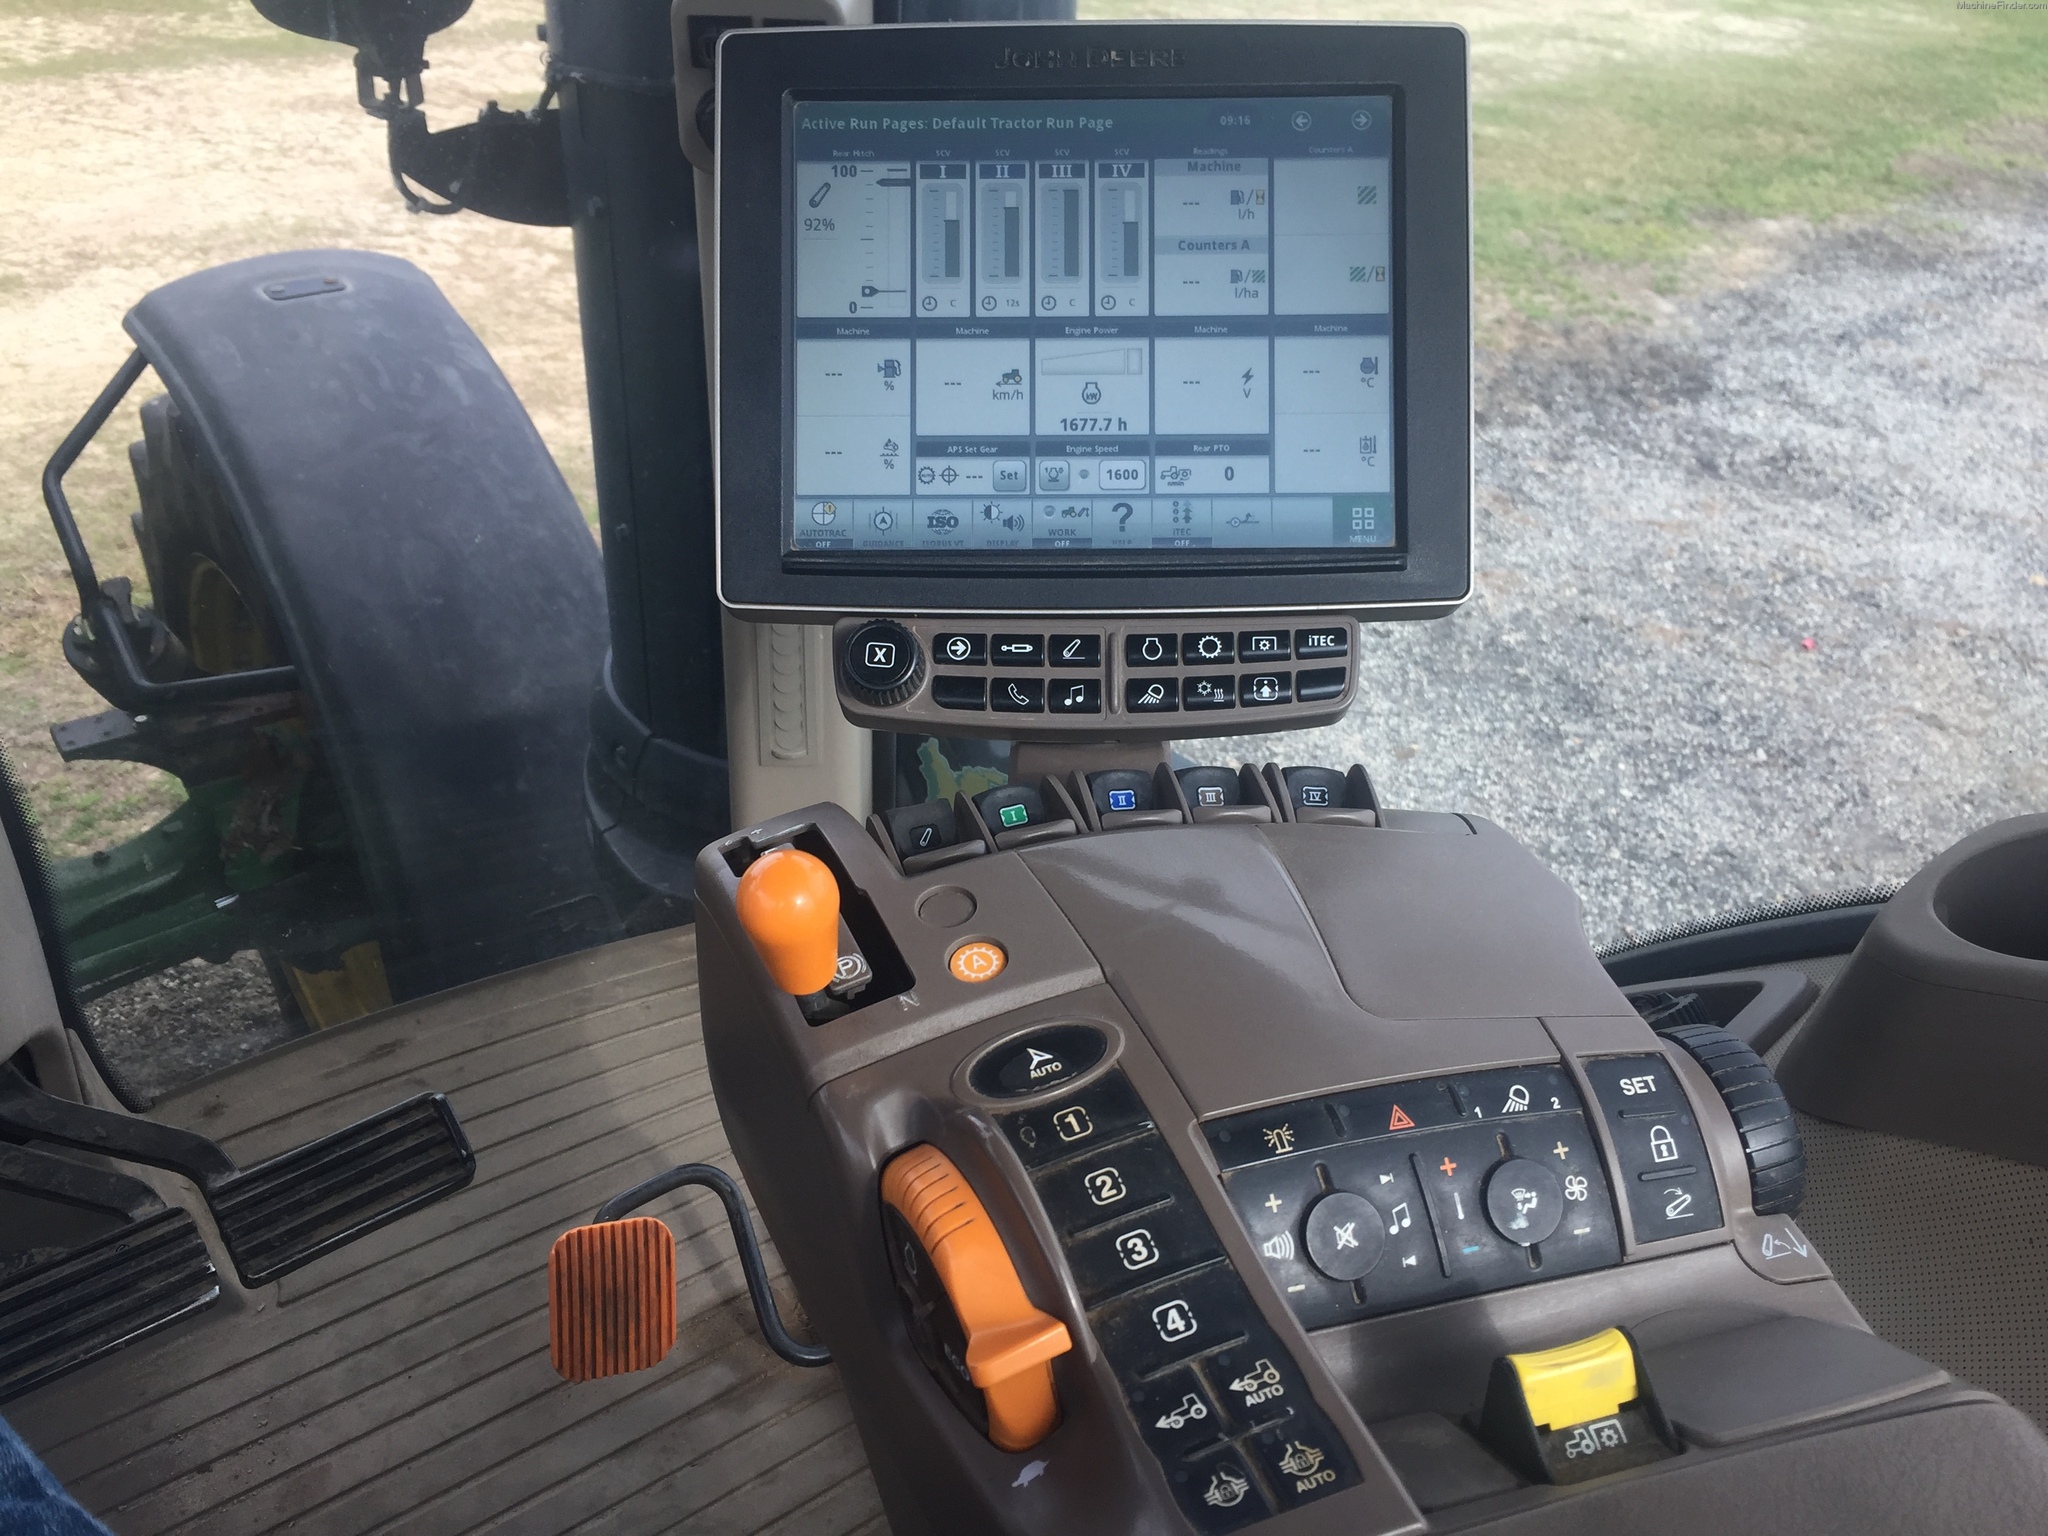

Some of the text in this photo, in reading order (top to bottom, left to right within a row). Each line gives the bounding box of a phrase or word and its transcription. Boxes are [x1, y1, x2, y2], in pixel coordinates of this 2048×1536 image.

[802, 116, 1114, 133] Active Run Pages: Default Tractor Run Page
[1220, 114, 1251, 127] 09:16
[832, 149, 850, 158] Rear
[831, 164, 858, 178] 100
[995, 164, 1010, 178] II
[1051, 164, 1073, 178] III
[1111, 164, 1133, 178] IV
[1187, 160, 1242, 172] Machine
[804, 218, 835, 231] 92%
[1178, 239, 1250, 251] Counters A
[848, 301, 858, 314] 0
[836, 327, 870, 336] Machine
[955, 326, 990, 336] Machine
[1064, 326, 1119, 337] Engine Power
[1194, 325, 1228, 334] Machine
[1314, 324, 1348, 333] Machine
[992, 389, 1024, 401] km/h
[1243, 388, 1251, 399] V
[1059, 417, 1128, 432] 1677.7 h
[946, 445, 998, 454] APS Set Gear
[1066, 444, 1119, 455] Engine Speed
[1193, 444, 1231, 453] Rear PTO
[1000, 470, 1019, 481] Set
[1106, 468, 1139, 481] 1600
[1224, 466, 1235, 482] 0
[926, 515, 959, 530] ISO
[800, 529, 847, 538] AUTOTRAC
[1048, 528, 1077, 537] WORK
[1350, 534, 1377, 544] MENU
[815, 540, 832, 549] OFF
[1054, 540, 1071, 548] OFF
[1174, 539, 1190, 548] OFF
[1307, 633, 1336, 648] iTEC
[1205, 792, 1217, 803] III
[1309, 791, 1322, 802] IV
[971, 952, 988, 970] A
[1029, 1061, 1063, 1080] AUTO
[1619, 1074, 1657, 1096] SET
[1550, 1097, 1561, 1110] 2
[1473, 1106, 1482, 1119] 1
[1064, 1114, 1081, 1134] 1
[1096, 1175, 1118, 1198] 2
[1131, 1238, 1149, 1262] 3
[1165, 1307, 1187, 1332] 4
[1244, 1382, 1284, 1408] AUTO
[1296, 1469, 1336, 1494] AUTO
